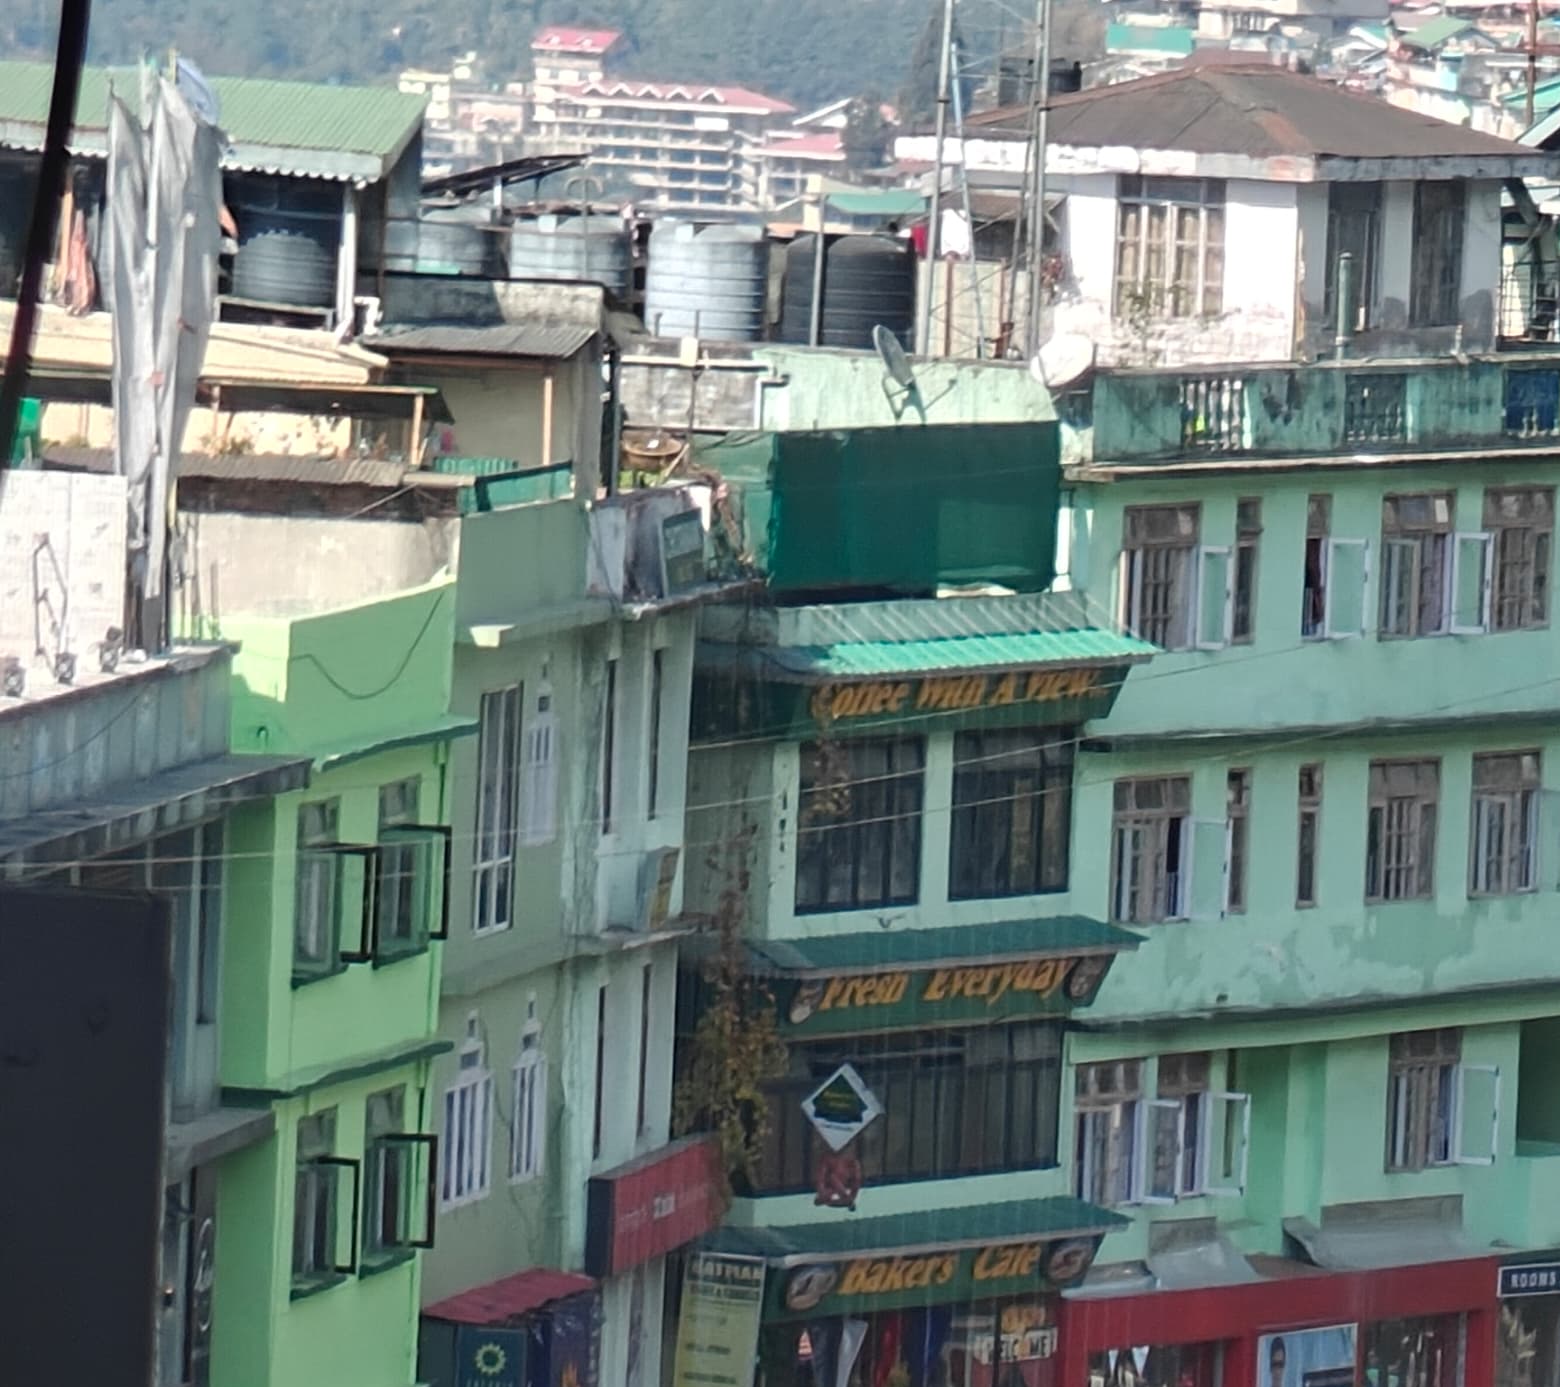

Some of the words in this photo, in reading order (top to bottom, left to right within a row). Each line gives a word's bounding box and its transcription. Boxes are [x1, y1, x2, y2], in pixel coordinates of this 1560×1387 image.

[818, 973, 911, 1011] Fresh
[926, 957, 1074, 1008] Everyday
[1510, 1271, 1557, 1289] ROOMS
